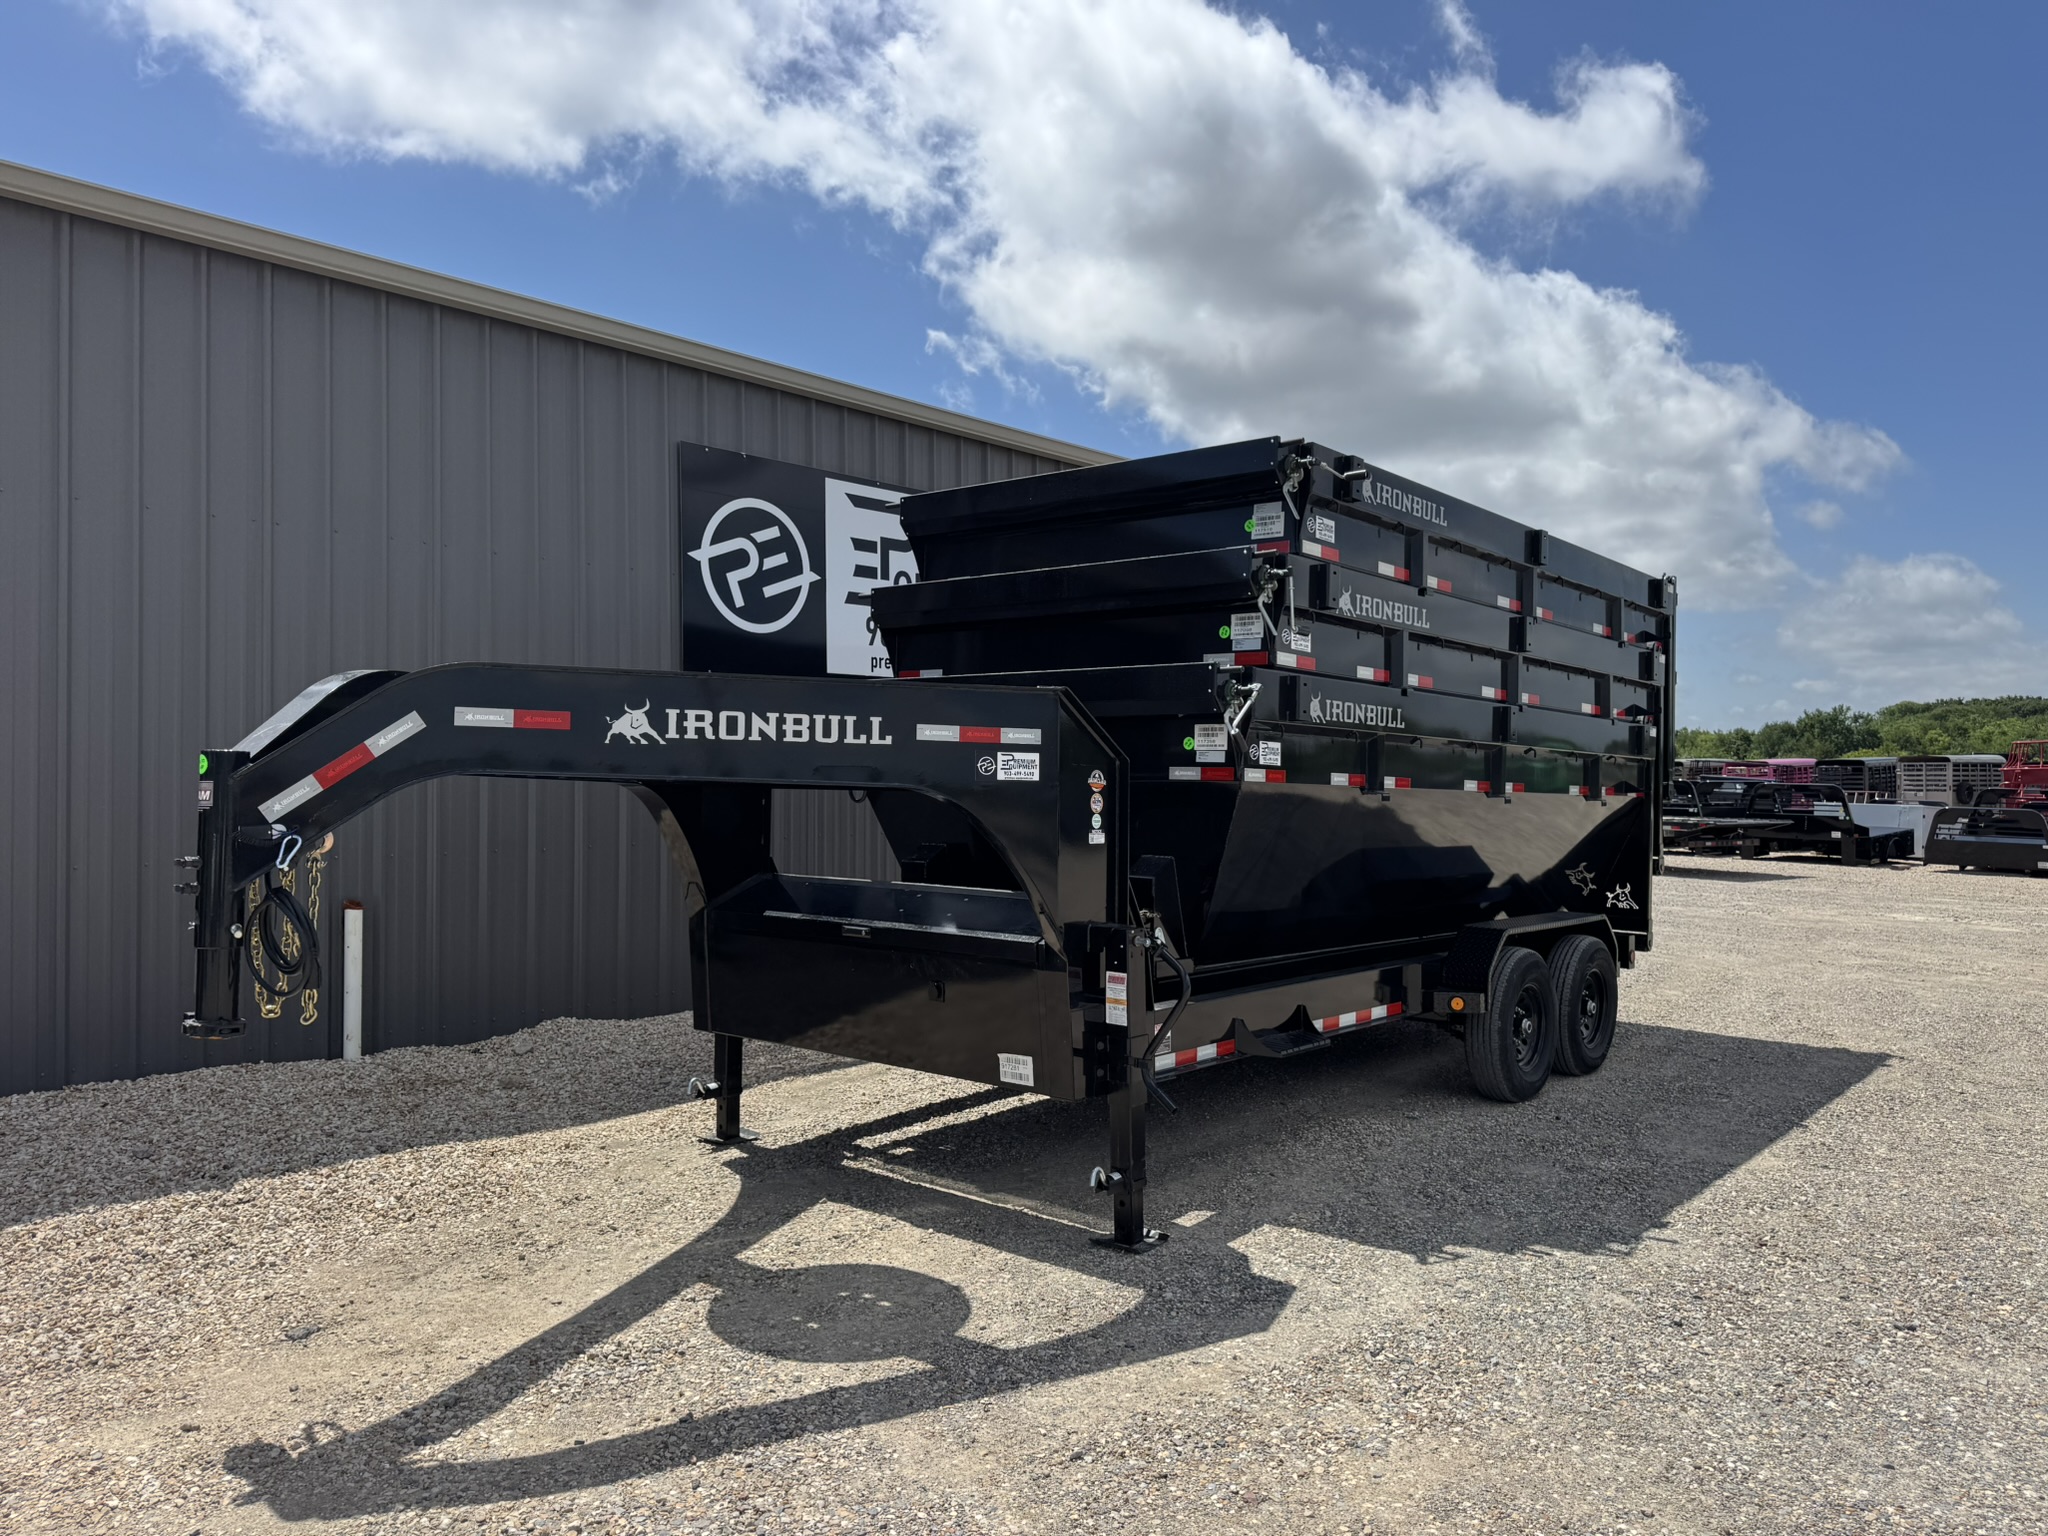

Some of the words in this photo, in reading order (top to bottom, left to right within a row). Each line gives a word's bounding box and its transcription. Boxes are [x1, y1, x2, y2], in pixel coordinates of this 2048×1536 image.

[1375, 481, 1448, 528] IRONBULL
[1355, 593, 1431, 629] IRONBULL
[665, 708, 893, 745] IRONBULL
[1325, 699, 1406, 729] IRONBULL
[385, 720, 414, 743] IRONBULL
[280, 784, 311, 807] IRONBULL
